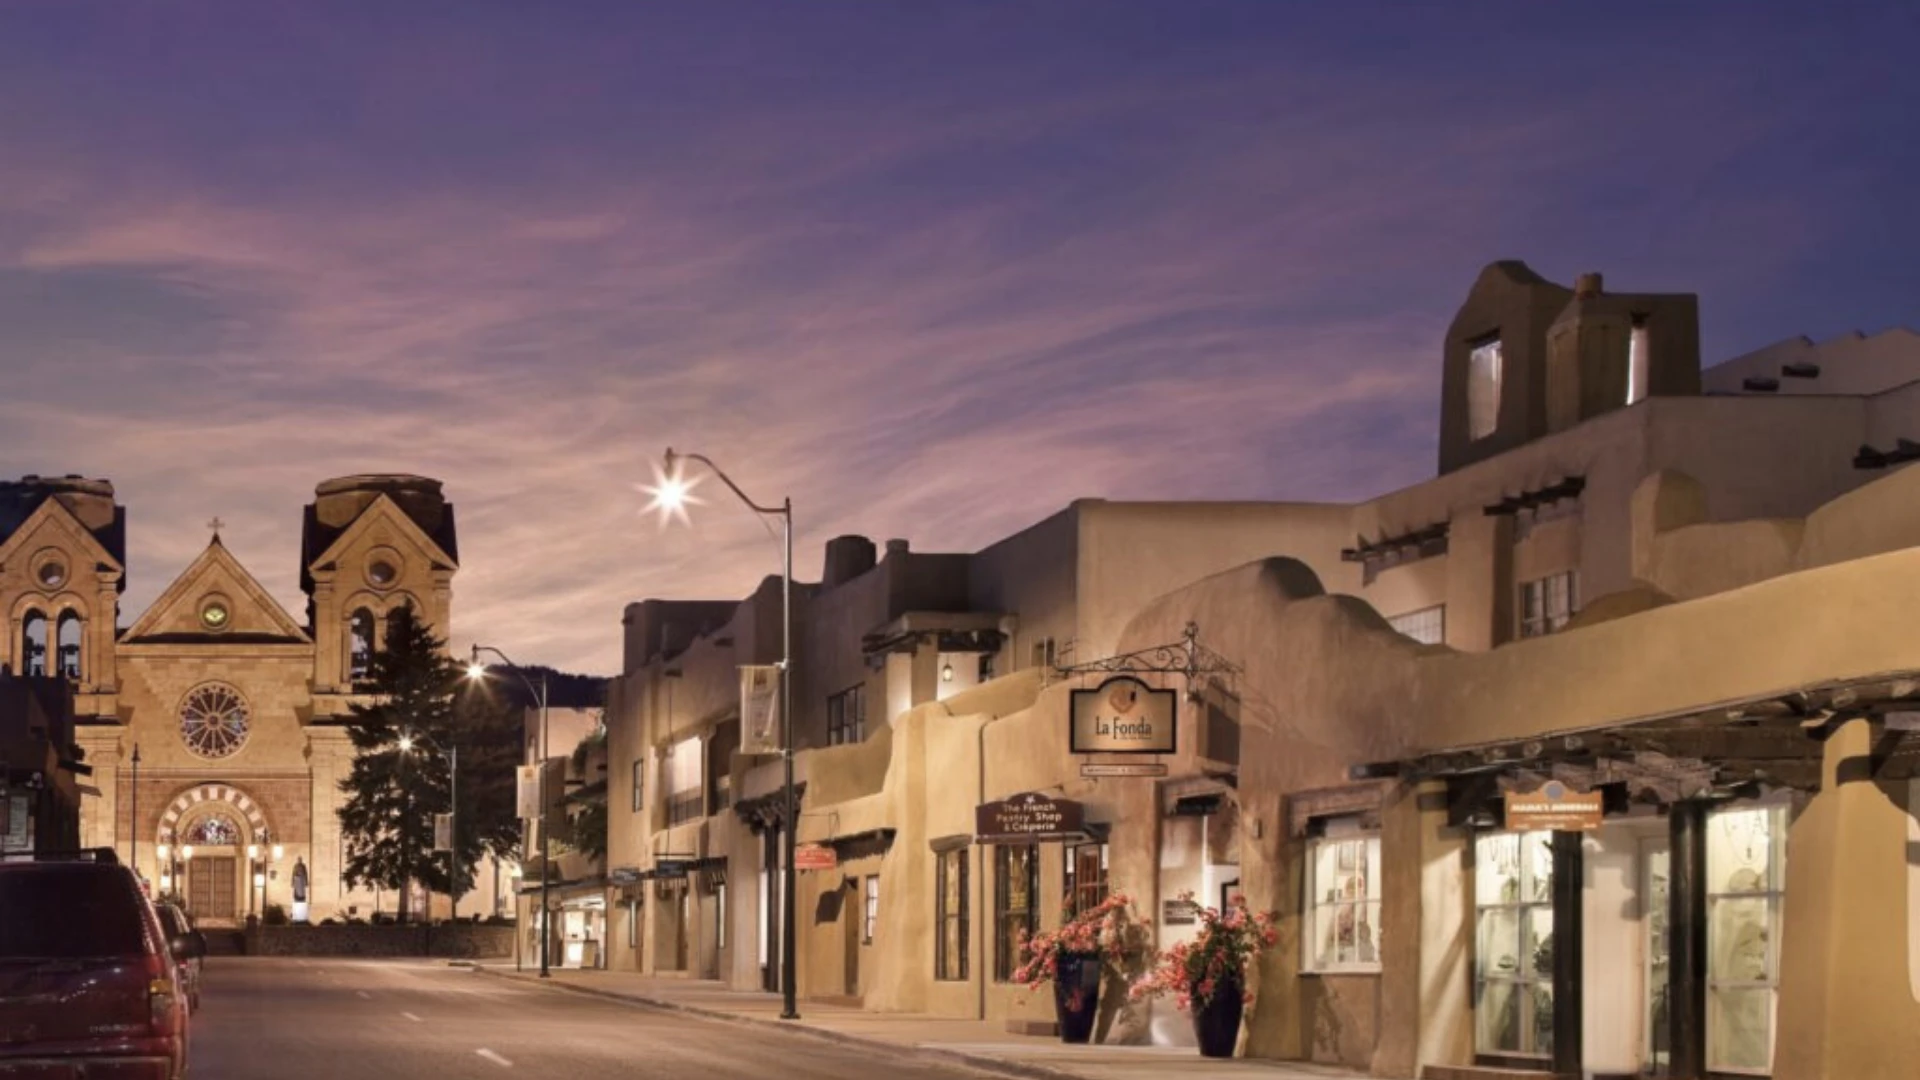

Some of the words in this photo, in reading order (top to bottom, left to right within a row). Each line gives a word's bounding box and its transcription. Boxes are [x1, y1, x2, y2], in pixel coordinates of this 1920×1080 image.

[1095, 715, 1110, 736] La
[1113, 715, 1152, 740] Fonda
[1003, 803, 1020, 813] The
[1023, 802, 1056, 812] French
[996, 813, 1030, 822] Pastry
[1035, 812, 1062, 822] Shop
